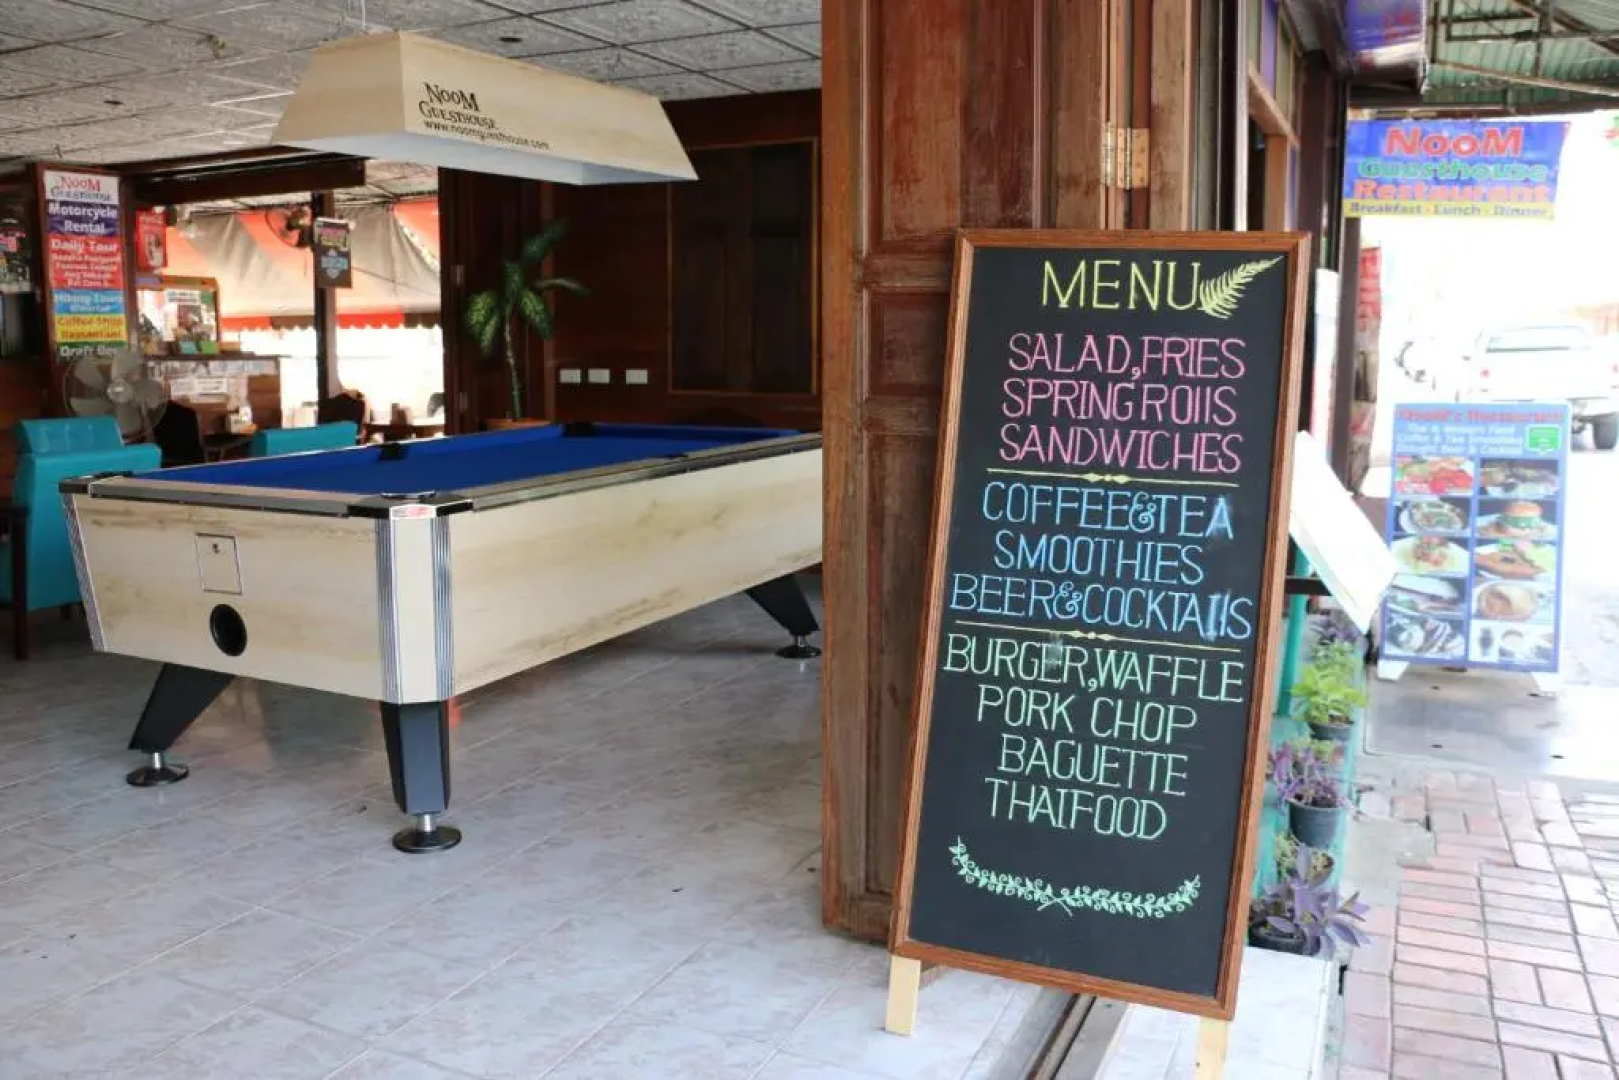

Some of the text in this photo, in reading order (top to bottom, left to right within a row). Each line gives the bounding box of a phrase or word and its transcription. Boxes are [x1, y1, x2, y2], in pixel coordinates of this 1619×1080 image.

[424, 82, 481, 112] NooM
[1385, 126, 1524, 156] NooM
[1358, 157, 1547, 180] Guesthouse
[49, 202, 117, 220] Motorcycle
[64, 220, 105, 233] Rental
[1042, 259, 1201, 311] MENU
[1002, 377, 1135, 421] SPRING
[999, 423, 1244, 473] SANDWICHES
[993, 529, 1204, 585] SMOOTHIES
[977, 684, 1197, 744] PORK CHOP
[998, 733, 1188, 797] BAGUETTE
